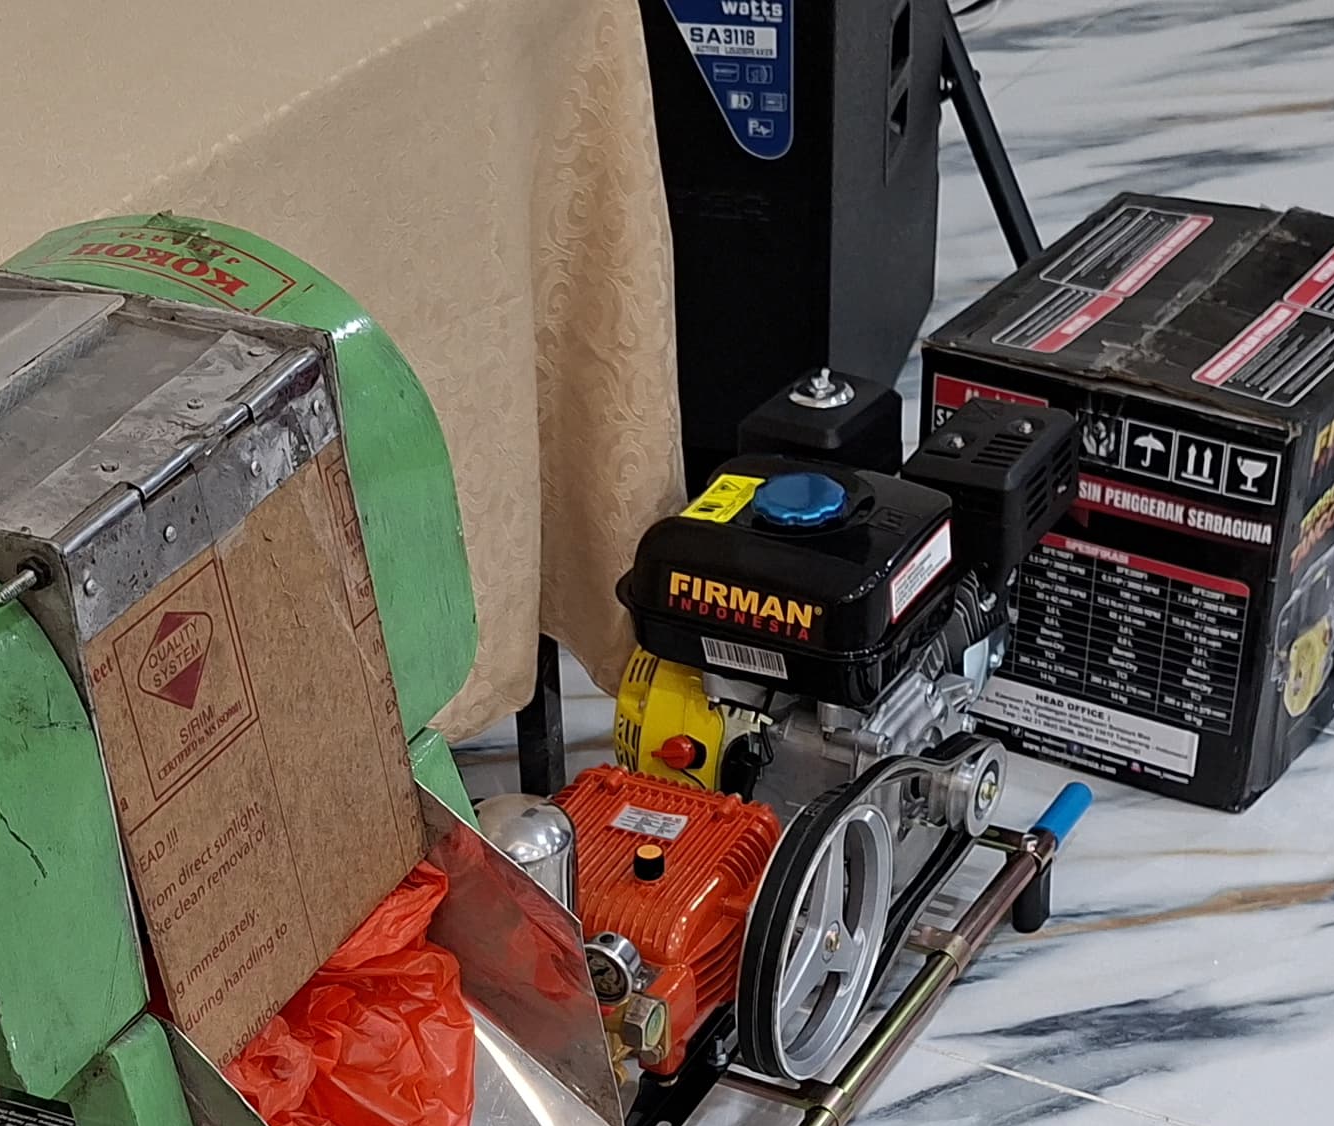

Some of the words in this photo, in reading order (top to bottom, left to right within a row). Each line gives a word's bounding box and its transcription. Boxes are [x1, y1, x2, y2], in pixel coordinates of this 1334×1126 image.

[721, 0, 783, 17] watts
[690, 27, 755, 46] SA3118
[69, 243, 251, 297] KOKOH
[1078, 480, 1102, 503] SIN
[1105, 487, 1185, 525] PENGGERAK
[1186, 508, 1273, 545] SERBAGUNA
[668, 595, 809, 641] INDONESIA
[669, 571, 813, 629] FIRMAN
[148, 620, 198, 669] QUALITY
[153, 639, 203, 688] SYSTEM
[90, 655, 113, 688] eet
[179, 704, 214, 745] SIRIM
[1036, 694, 1064, 708] HEAD
[1067, 699, 1105, 719] OFFICE
[157, 741, 197, 781] CERTIFIED
[136, 840, 165, 874] EAD
[179, 847, 213, 886] direct
[214, 801, 264, 852] sunlight.
[173, 884, 206, 921] clean
[207, 834, 254, 889] removal
[255, 821, 268, 842] of
[185, 909, 260, 985] immediately.
[185, 988, 224, 1031] during
[223, 936, 275, 992] handling
[275, 923, 287, 940] to
